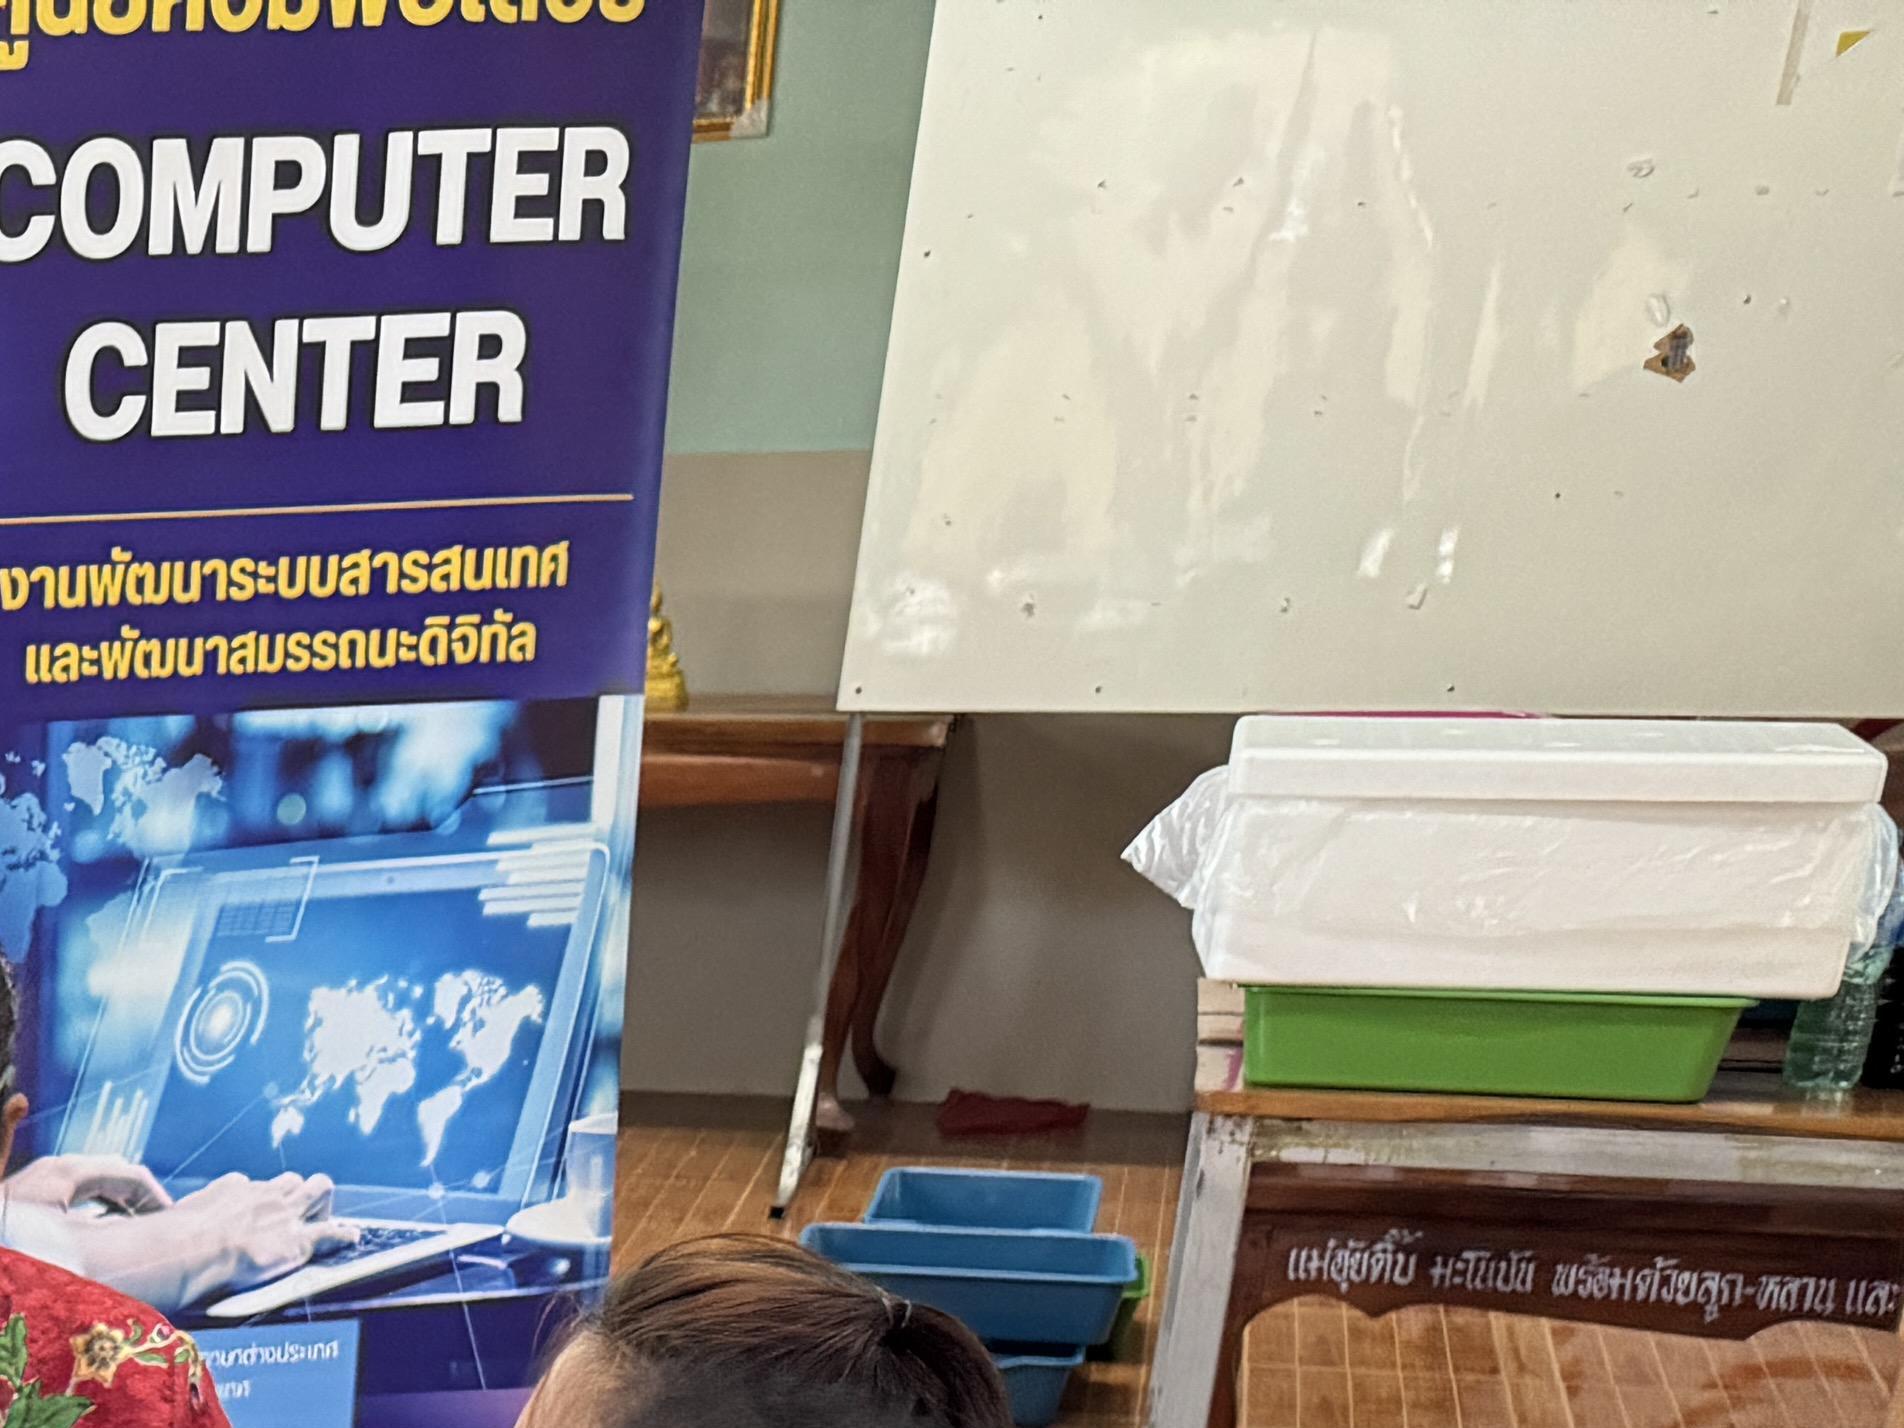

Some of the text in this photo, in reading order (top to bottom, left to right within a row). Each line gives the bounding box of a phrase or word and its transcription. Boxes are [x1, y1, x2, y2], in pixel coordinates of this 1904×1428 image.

[64, 310, 527, 442] CENTER
[24, 607, 537, 685] และพัฒนาสมรรถนะดิจิทัล
